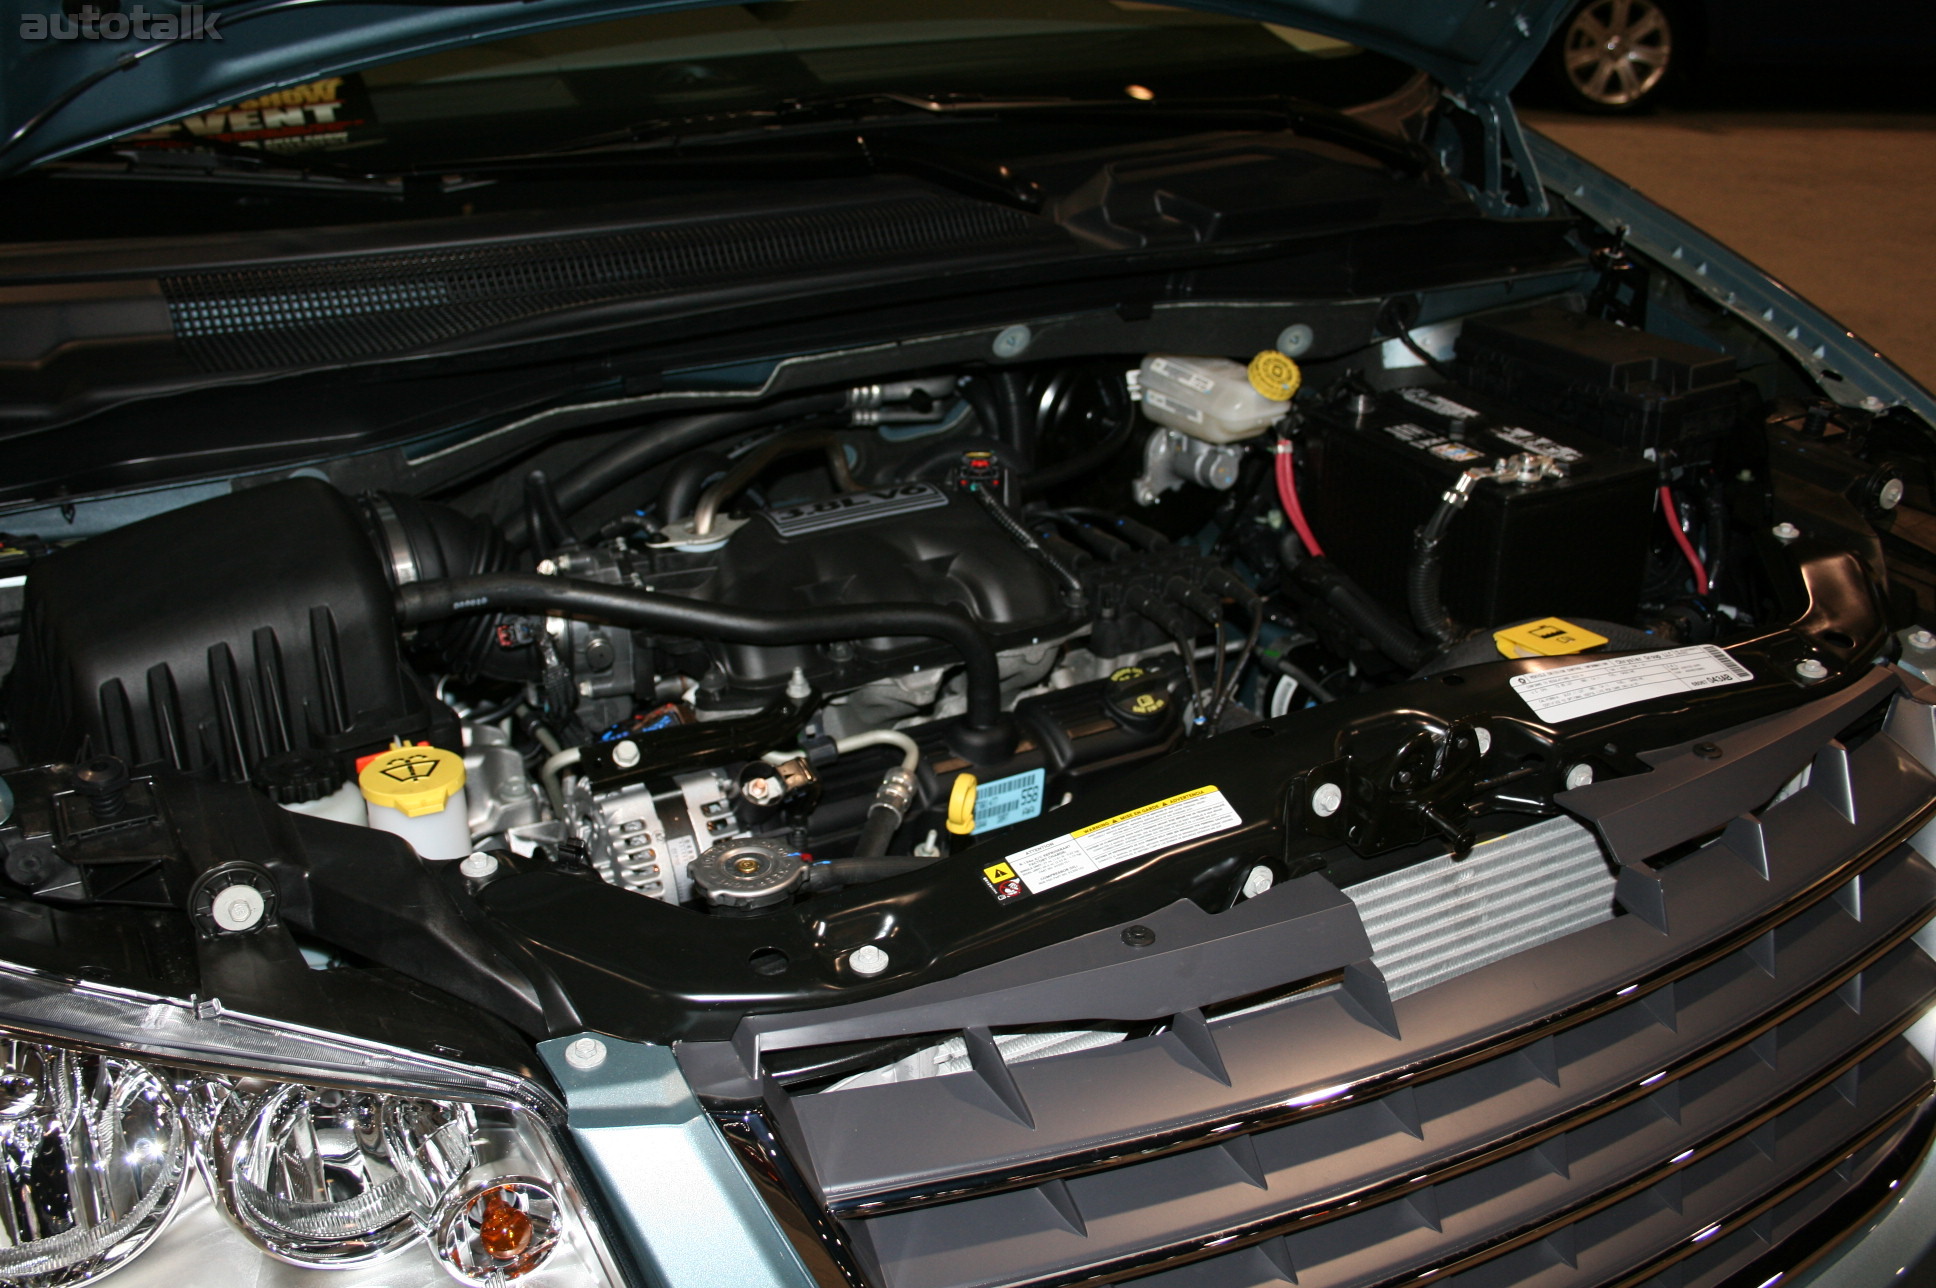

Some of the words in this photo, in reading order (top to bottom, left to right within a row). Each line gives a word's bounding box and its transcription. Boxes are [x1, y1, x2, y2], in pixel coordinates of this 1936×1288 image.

[780, 498, 871, 521] 3.8L
[871, 485, 928, 500] V6
[1083, 822, 1110, 834] WARNING
